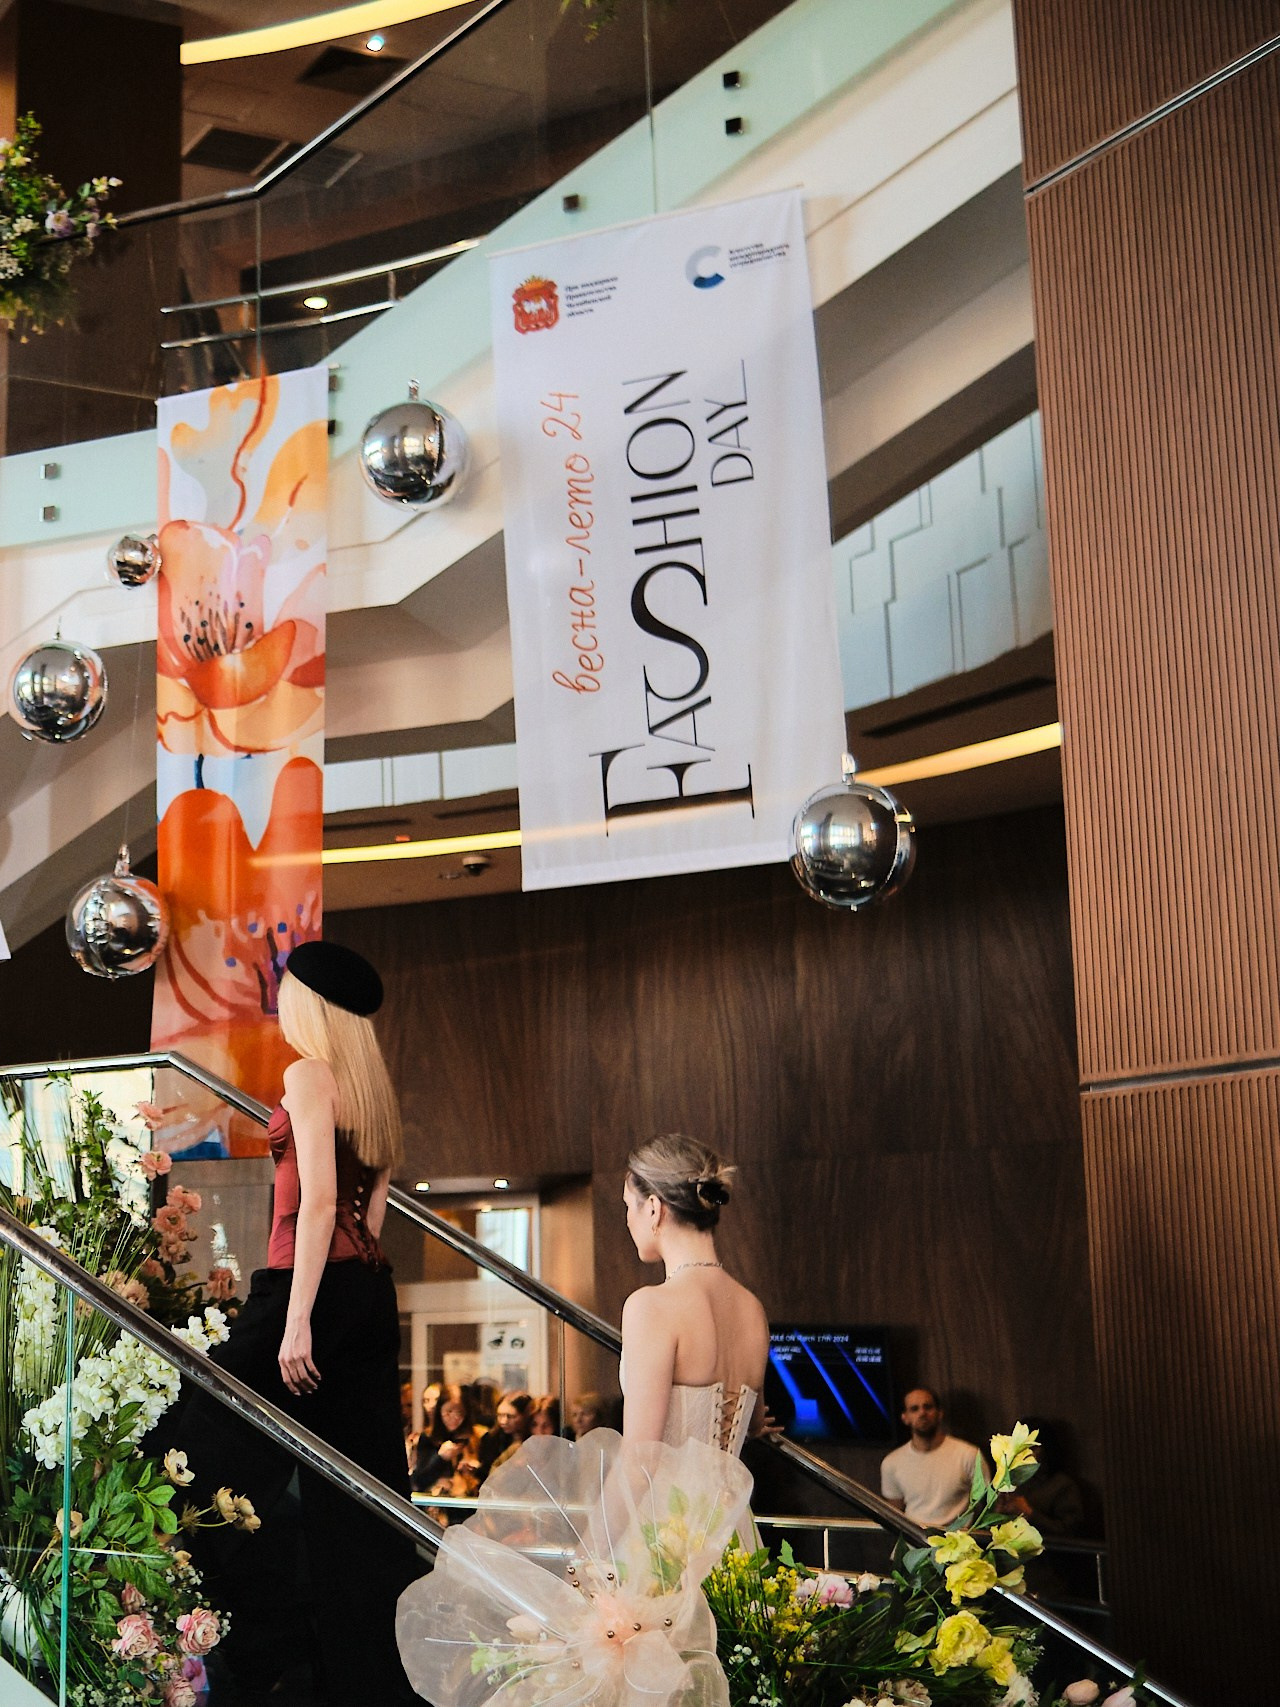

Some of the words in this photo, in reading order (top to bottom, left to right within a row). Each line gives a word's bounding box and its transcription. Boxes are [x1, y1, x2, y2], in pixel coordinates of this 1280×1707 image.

[541, 391, 582, 441] 24
[704, 359, 754, 487] DAY
[552, 453, 604, 695] весна-лето
[588, 370, 755, 837] FASHION
